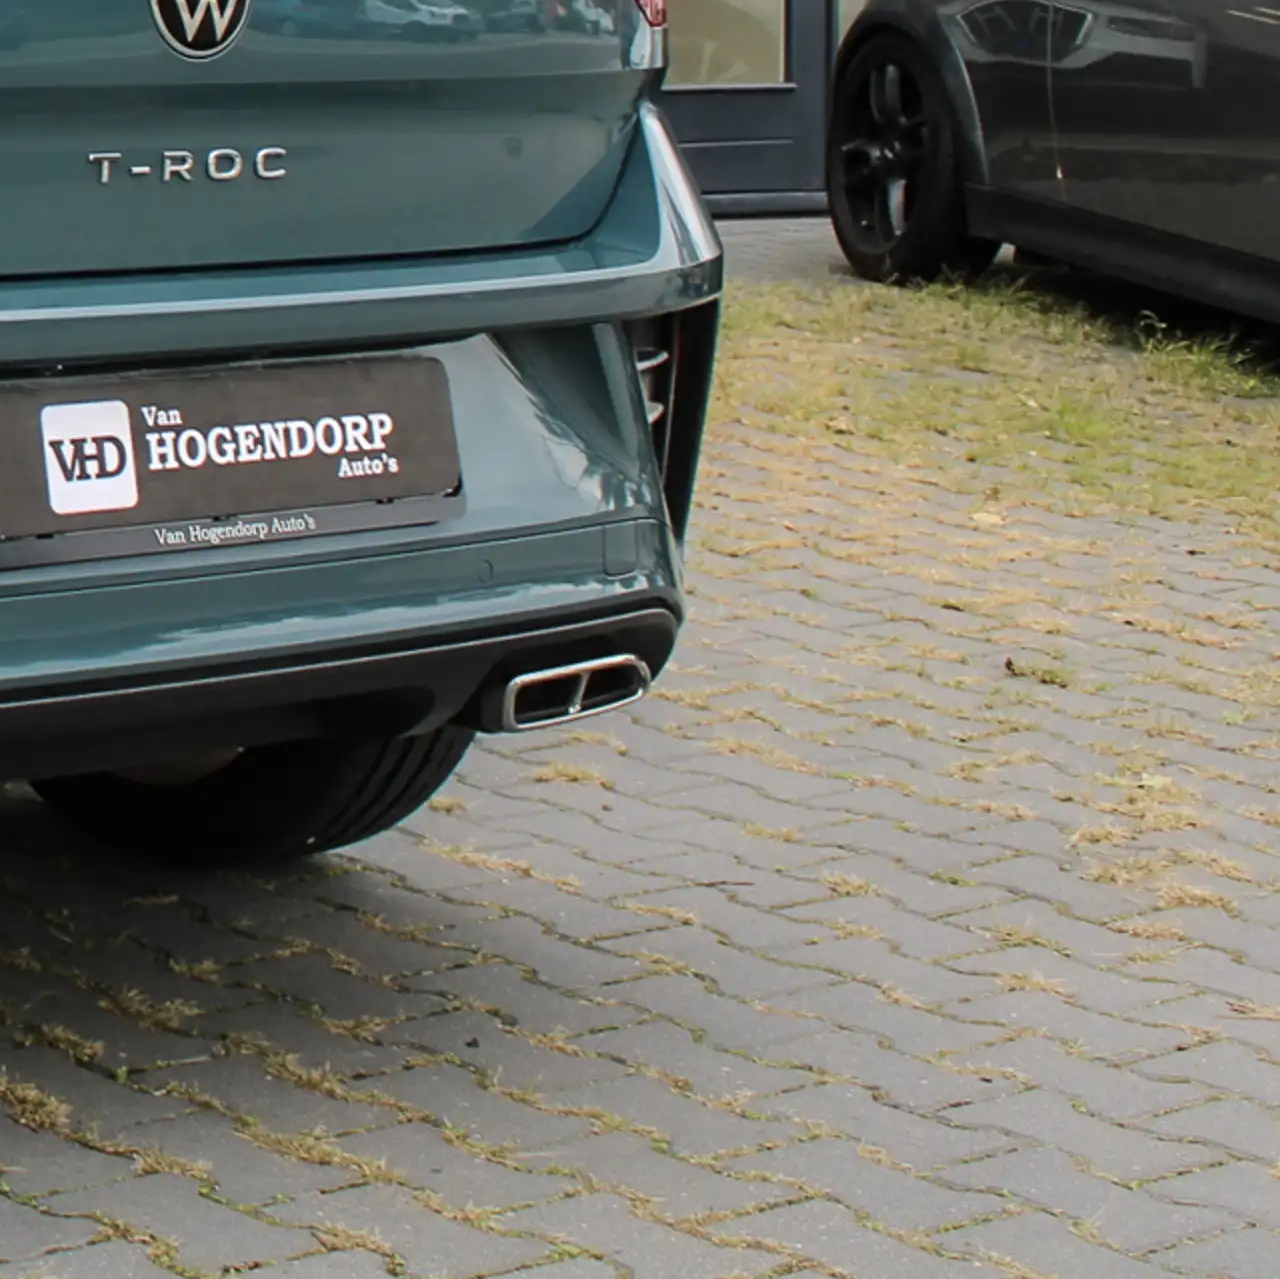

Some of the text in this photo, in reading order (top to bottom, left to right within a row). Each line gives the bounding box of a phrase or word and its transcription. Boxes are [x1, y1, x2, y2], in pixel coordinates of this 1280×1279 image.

[88, 147, 288, 183] T-ROC
[142, 404, 183, 426] Van
[146, 412, 394, 471] HOGENDORP
[49, 435, 127, 483] VHD
[338, 453, 399, 478] Auto's
[154, 514, 317, 546] Van Hogendorp Auto's
